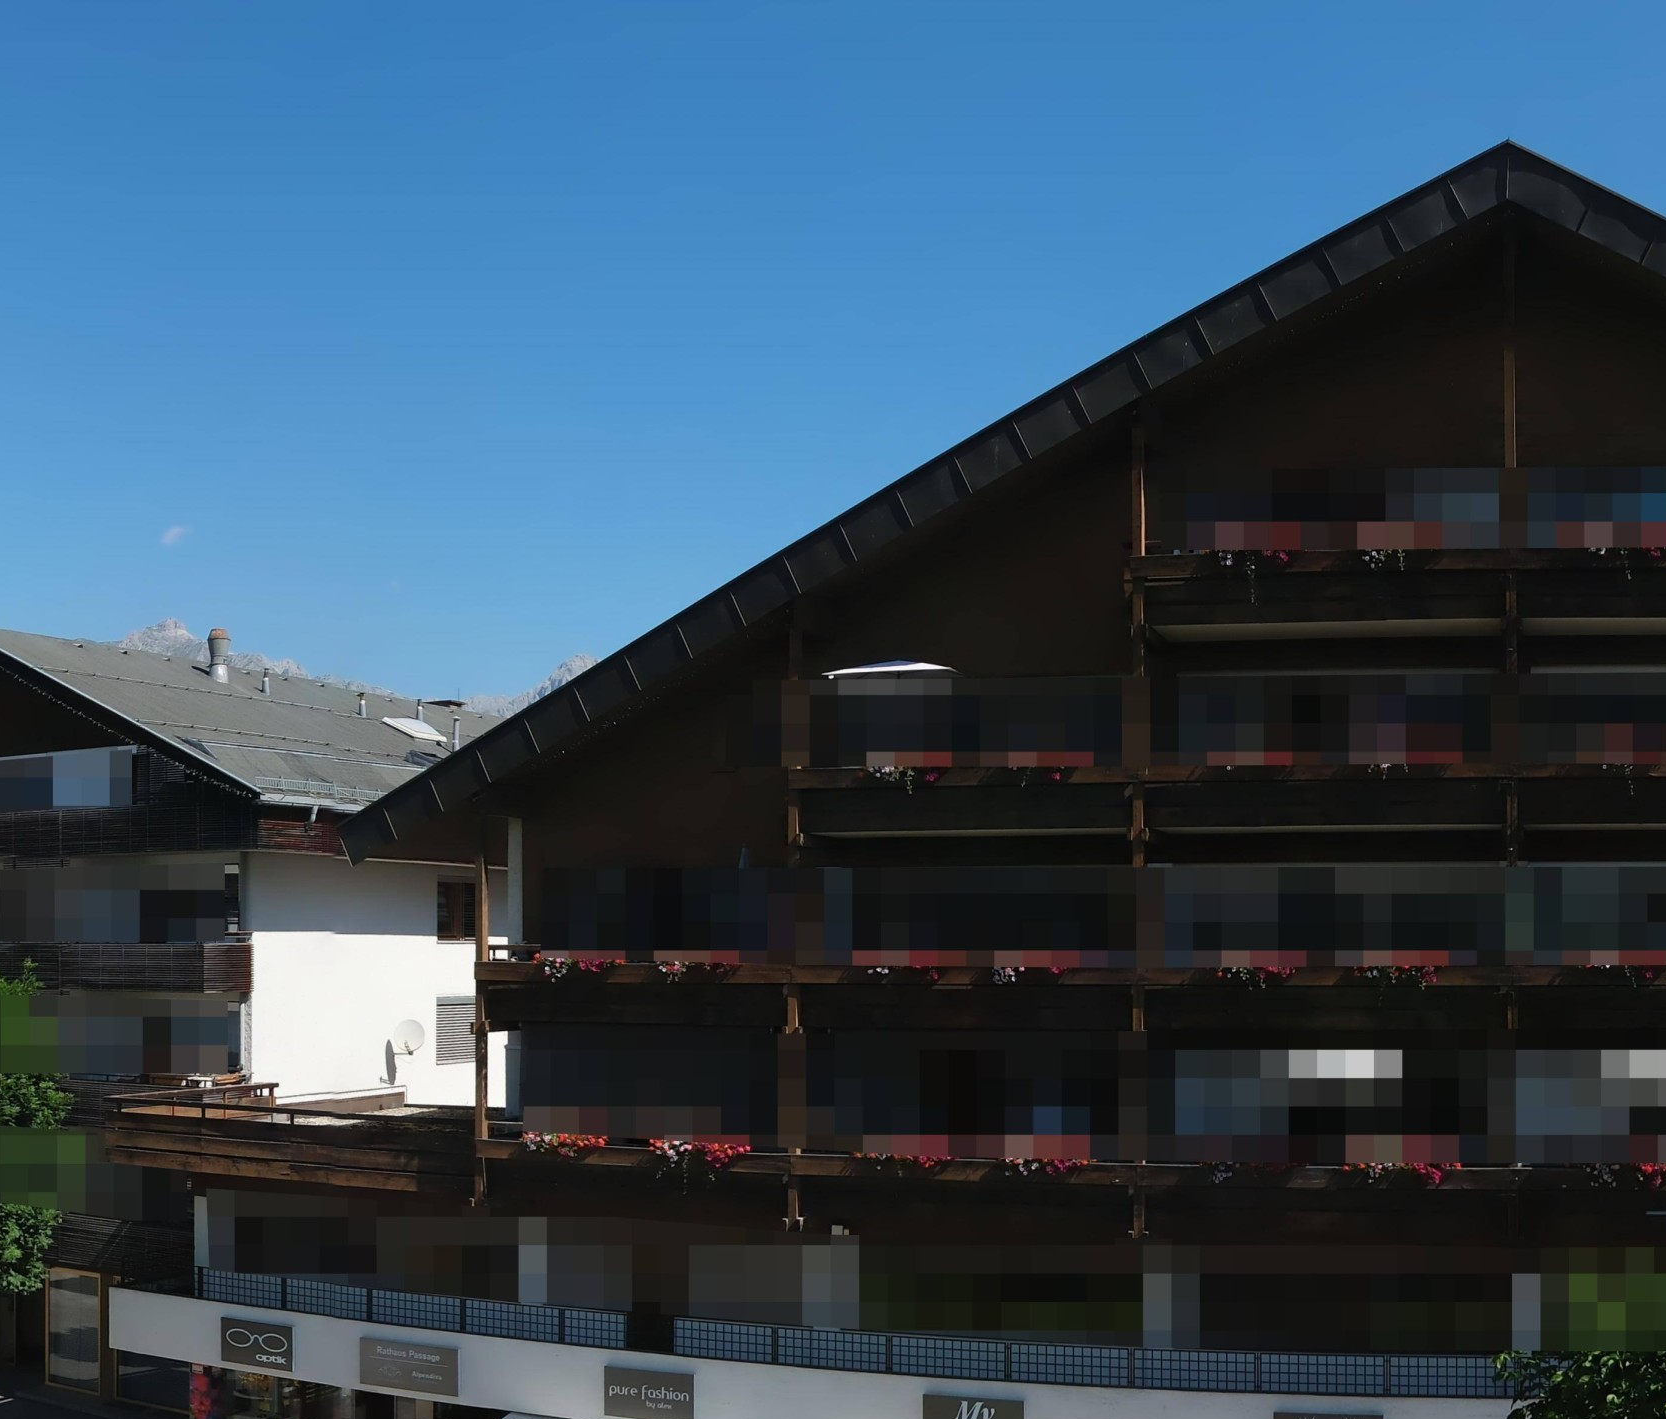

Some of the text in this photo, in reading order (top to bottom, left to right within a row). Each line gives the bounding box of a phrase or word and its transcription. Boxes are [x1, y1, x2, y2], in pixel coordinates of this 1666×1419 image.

[255, 1353, 287, 1366] optik
[377, 1345, 441, 1363] Rathaus Passage
[609, 1384, 689, 1402] pure fashion
[646, 1400, 655, 1409] by
